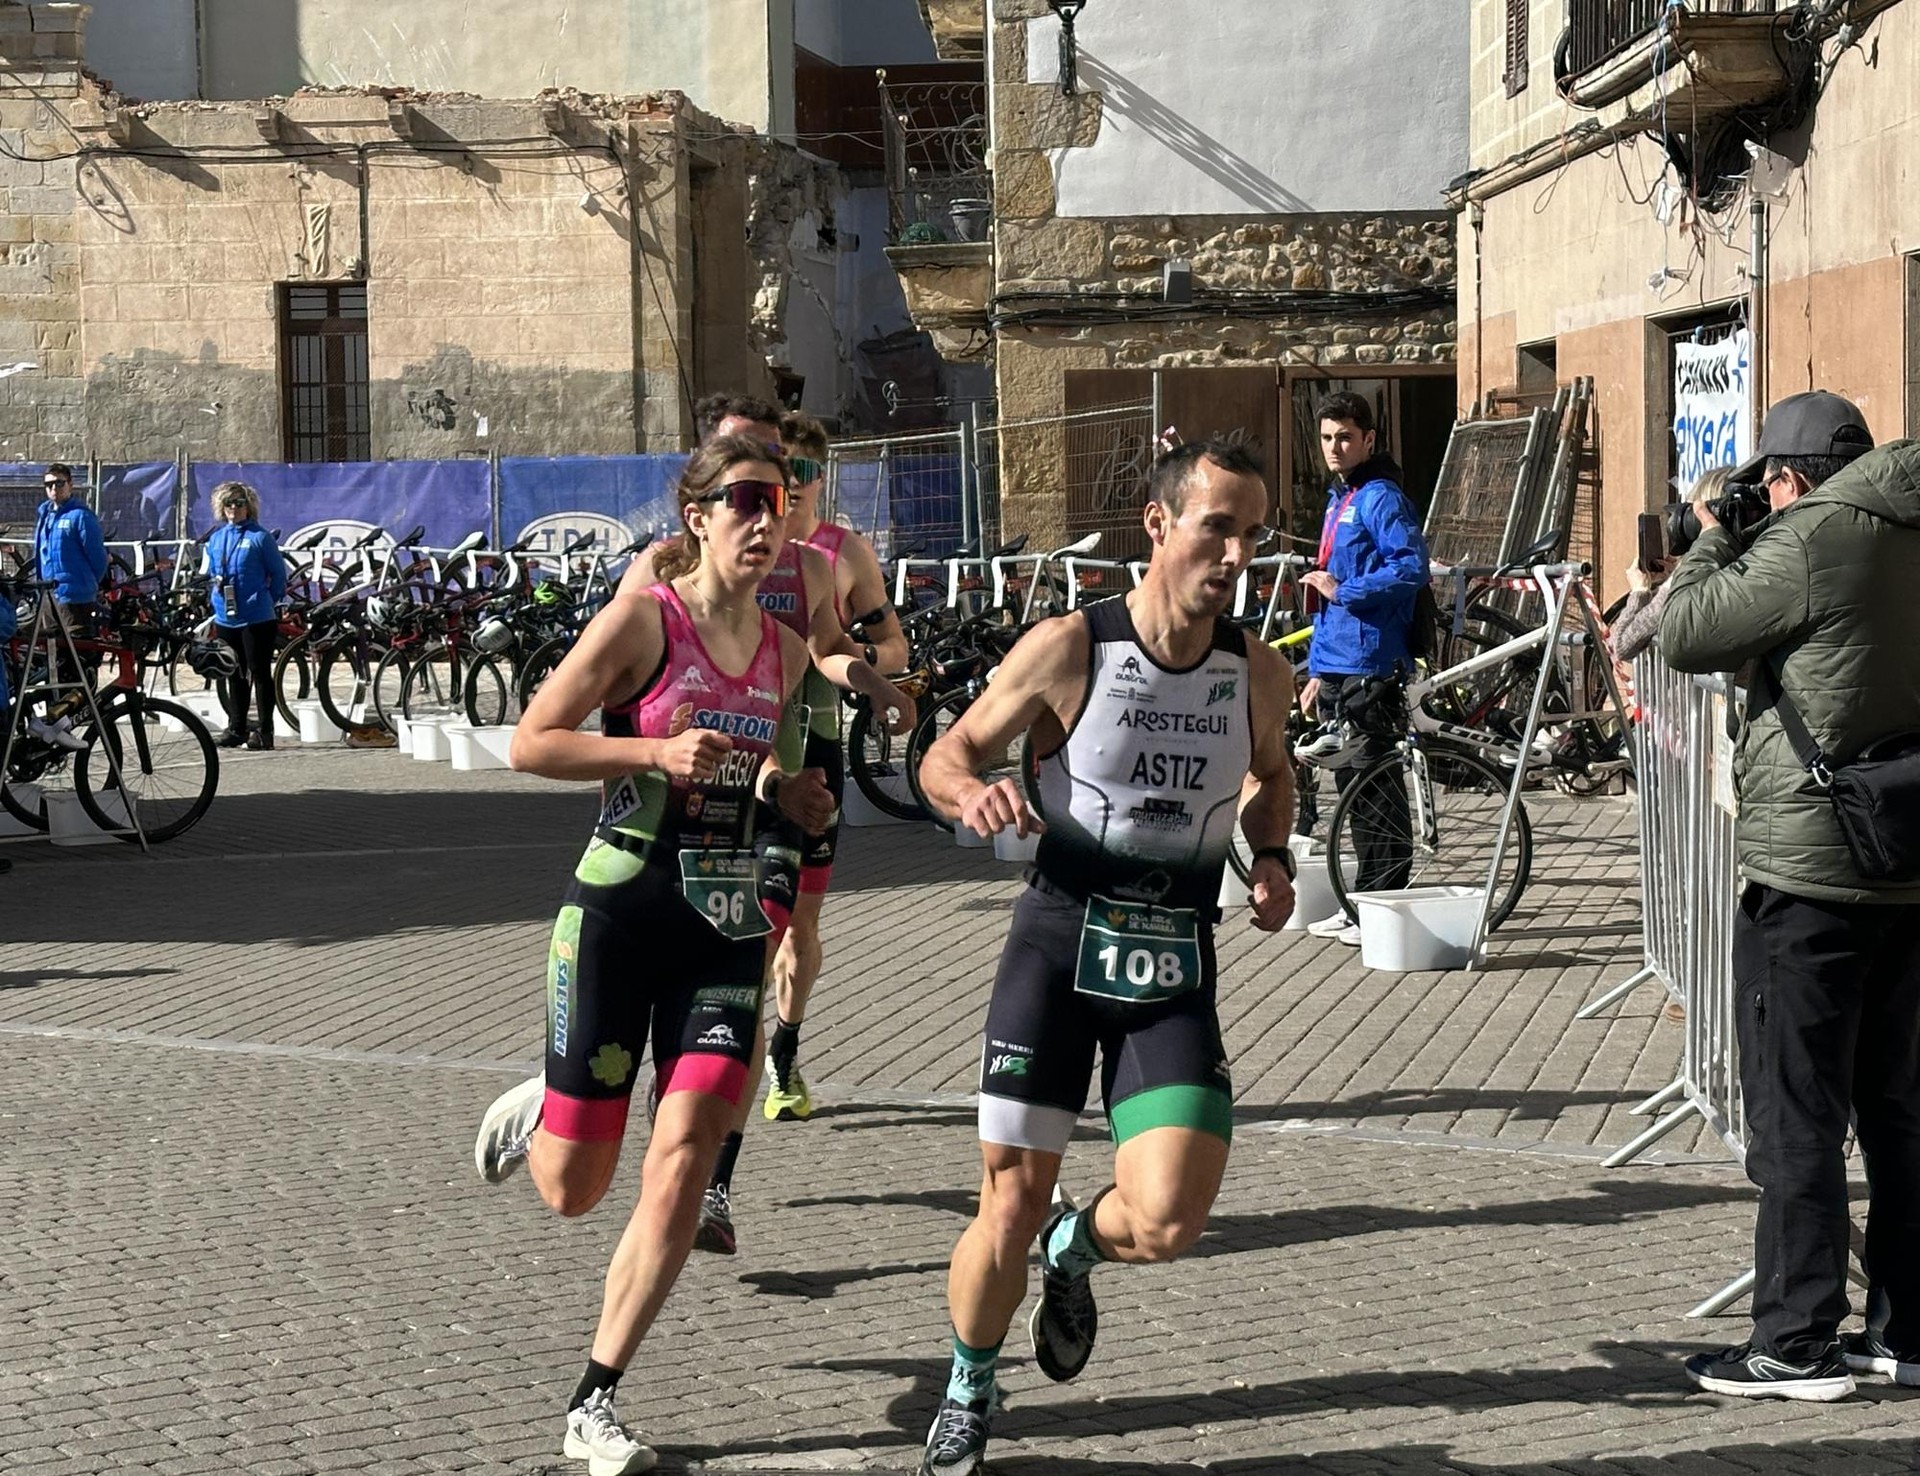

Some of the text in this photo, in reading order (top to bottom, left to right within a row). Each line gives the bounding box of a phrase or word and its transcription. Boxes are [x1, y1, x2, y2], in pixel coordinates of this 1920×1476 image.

[693, 708, 777, 743] SALTOKI
[1129, 751, 1208, 791] ASTIZ
[706, 889, 745, 925] 96
[1098, 944, 1184, 988] 108
[554, 957, 570, 1058] SALTOKI
